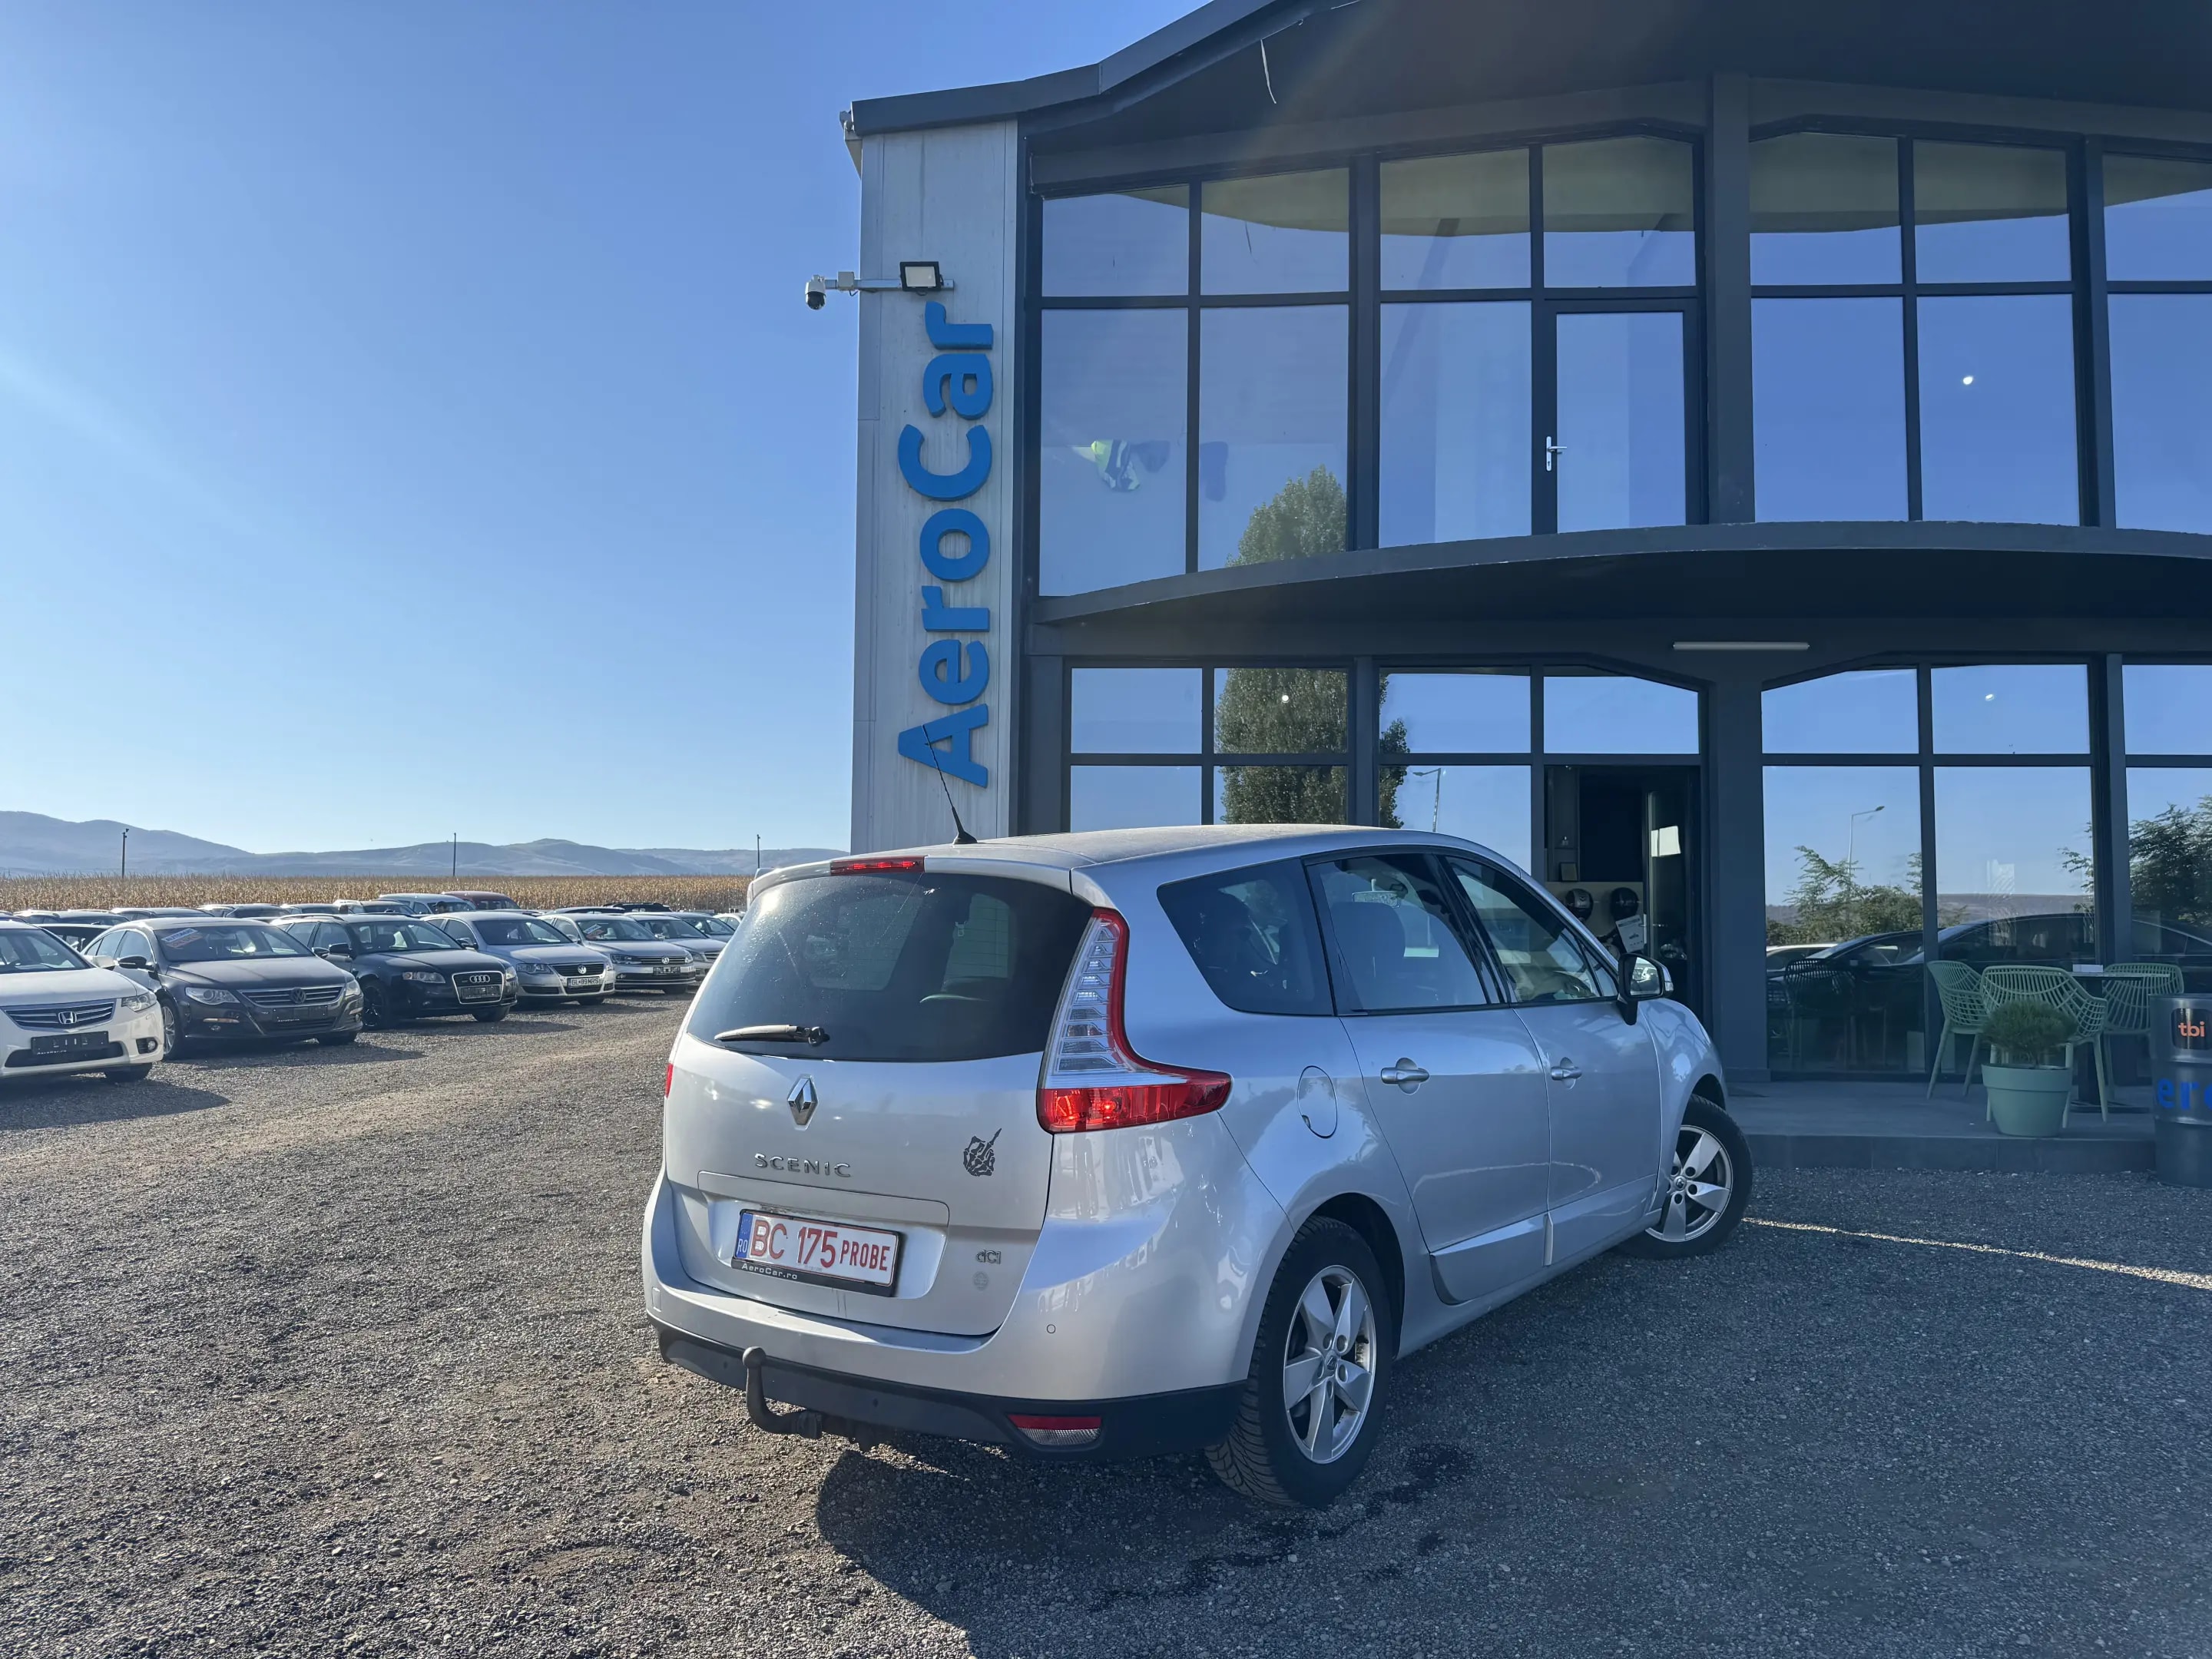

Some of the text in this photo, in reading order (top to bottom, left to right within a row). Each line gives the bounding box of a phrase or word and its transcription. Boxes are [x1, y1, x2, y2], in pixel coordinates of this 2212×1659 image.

[897, 300, 995, 790] AeroCar
[2178, 1021, 2205, 1037] tbi
[754, 1153, 851, 1177] SCENIC
[737, 1219, 890, 1272] RO BC 175 PROBE
[741, 1263, 798, 1280] AeroCar.ro
